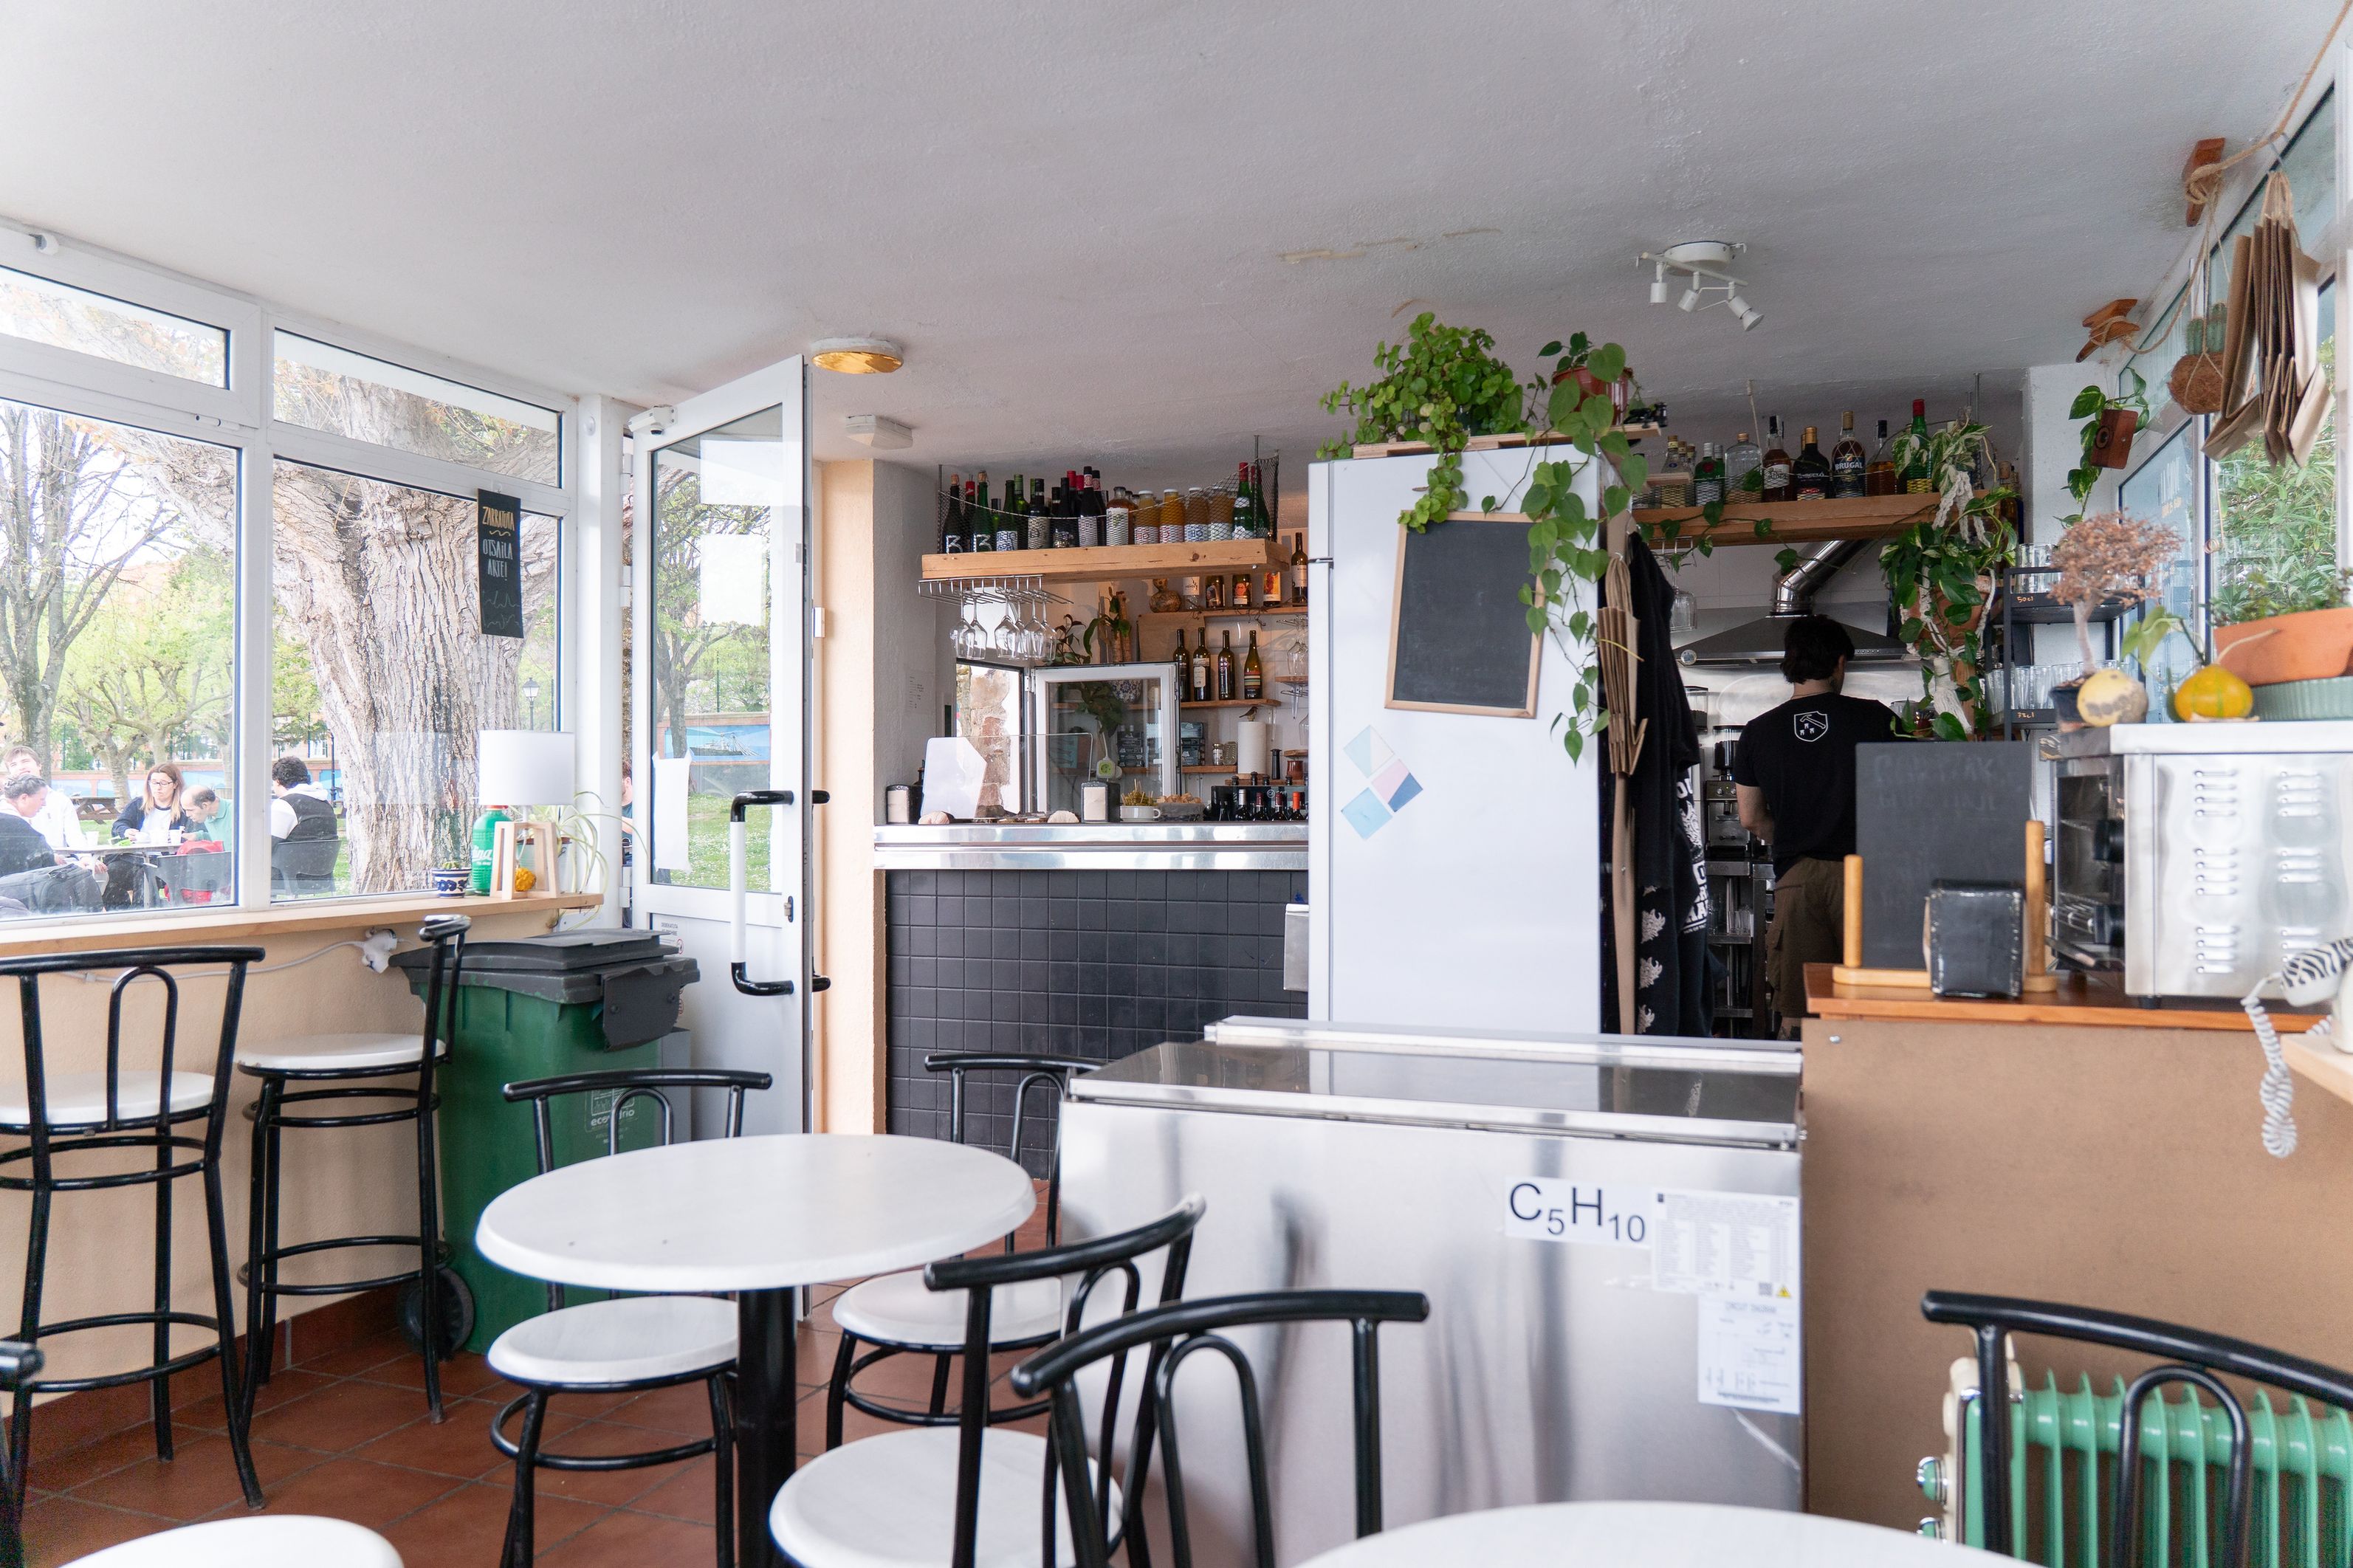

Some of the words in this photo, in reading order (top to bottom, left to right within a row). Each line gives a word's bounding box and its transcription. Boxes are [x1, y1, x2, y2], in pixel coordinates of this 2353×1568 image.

[1835, 461, 1863, 470] BRUGAL
[482, 506, 515, 531] ZARRATUTA
[487, 558, 507, 581] ARTE!
